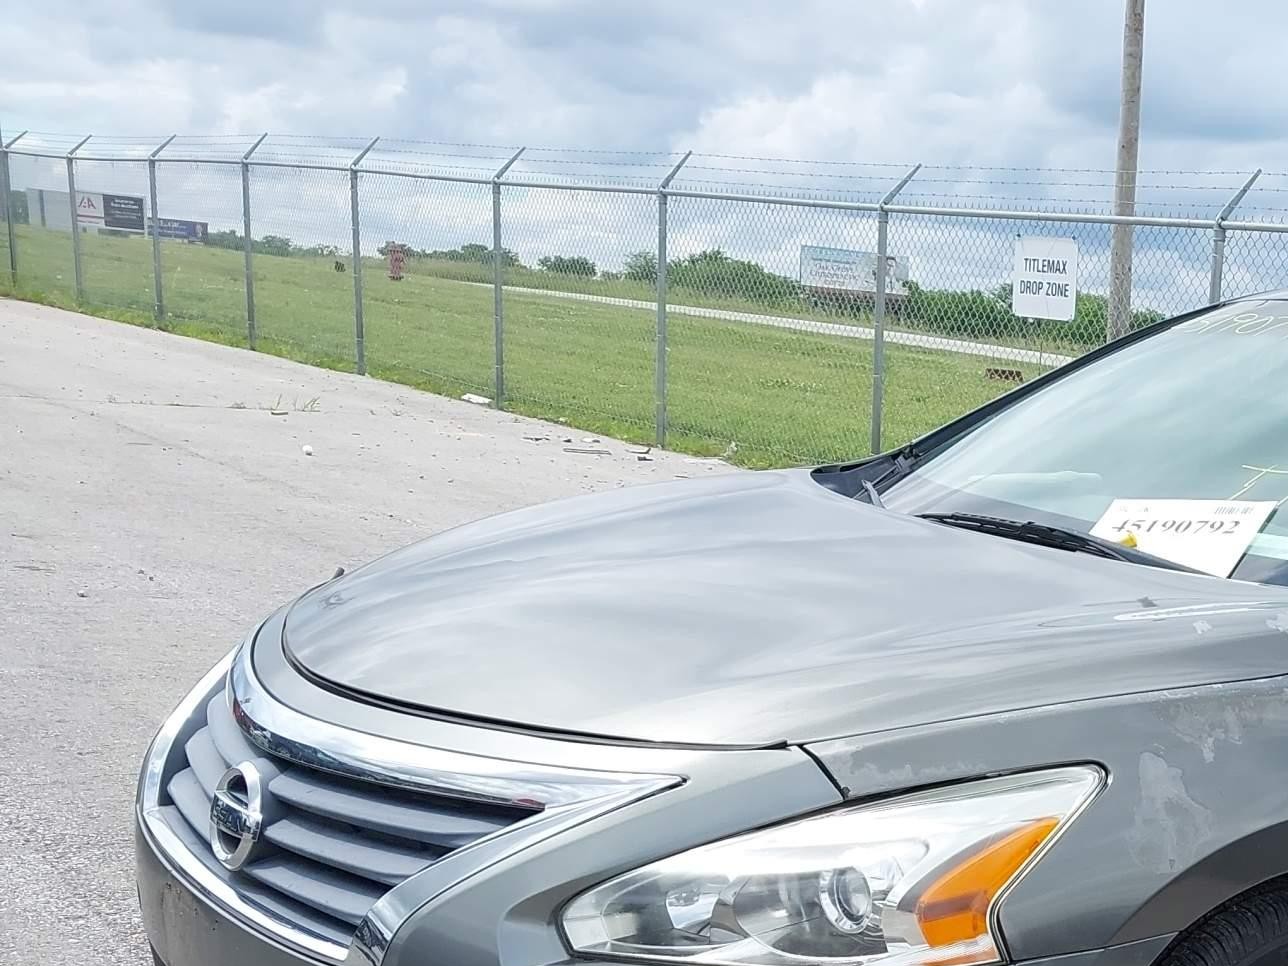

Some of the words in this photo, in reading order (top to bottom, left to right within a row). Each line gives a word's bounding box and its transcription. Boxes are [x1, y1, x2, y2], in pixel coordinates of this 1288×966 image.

[1023, 257, 1068, 275] TITLEMAX
[1019, 279, 1044, 296] DROP
[1045, 282, 1070, 298] ZONE
[1111, 518, 1241, 535] 45190792
